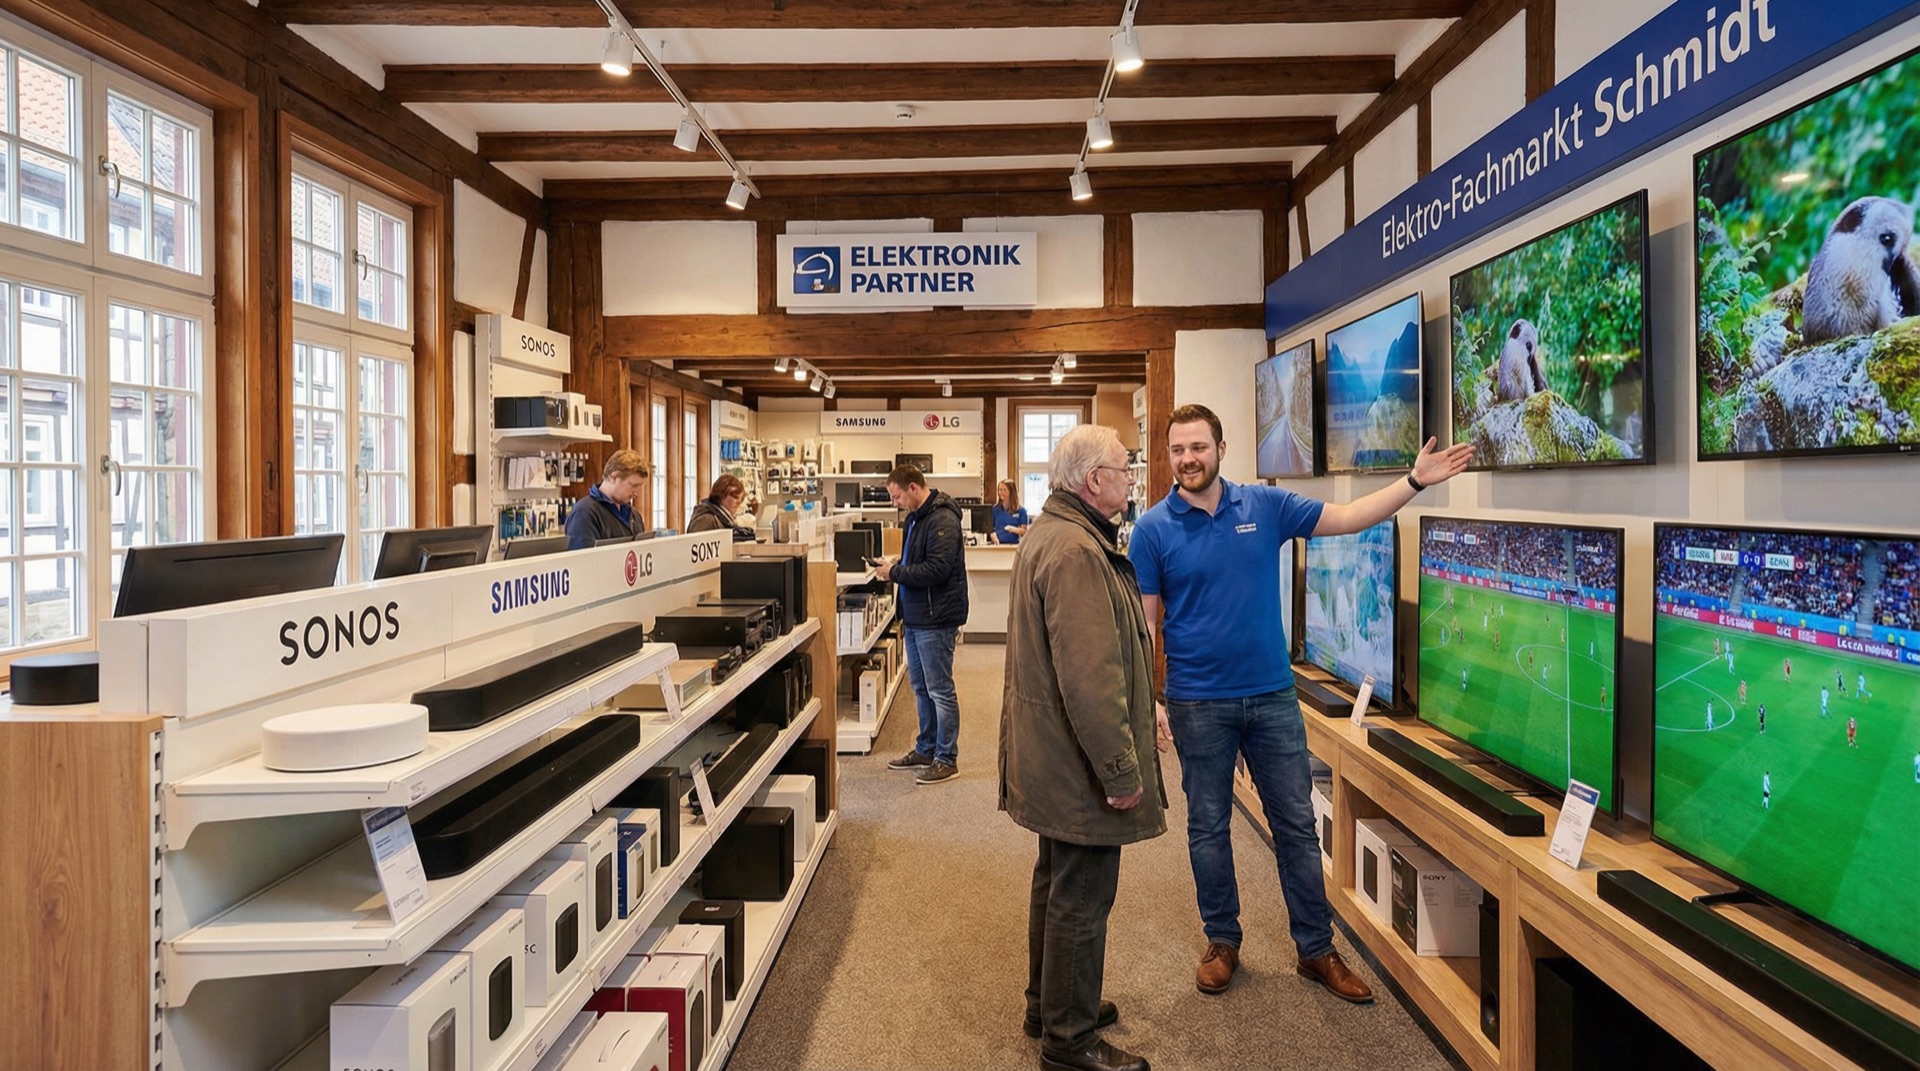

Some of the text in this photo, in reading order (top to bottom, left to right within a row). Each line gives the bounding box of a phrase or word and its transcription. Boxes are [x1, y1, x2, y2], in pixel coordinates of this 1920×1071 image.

[1382, 0, 1776, 259] Elektro-Fachmarkt Schmidt
[851, 244, 1021, 267] ELEKTRONIK
[851, 271, 975, 293] PARTNER
[521, 334, 556, 358] SONOS
[836, 417, 886, 427] SAMSUNG
[942, 416, 960, 428] LG
[691, 540, 721, 564] SONY
[639, 552, 653, 578] LG
[491, 568, 570, 614] SAMSUNG
[279, 601, 400, 666] SONOS
